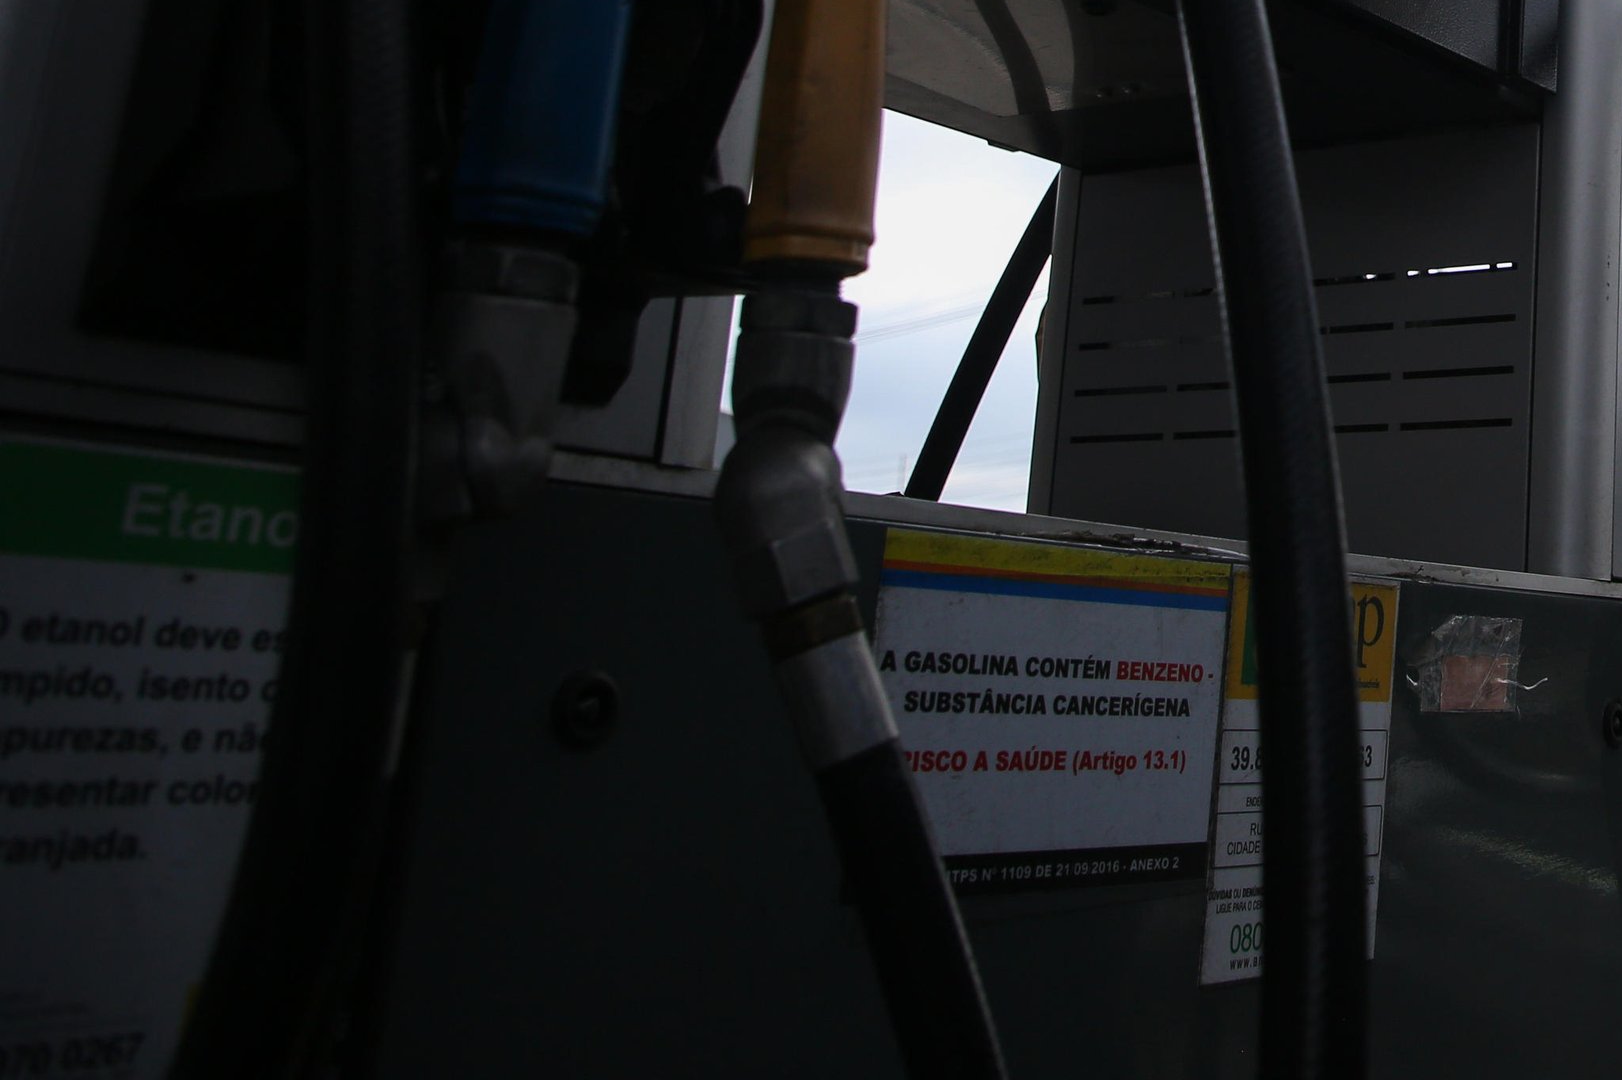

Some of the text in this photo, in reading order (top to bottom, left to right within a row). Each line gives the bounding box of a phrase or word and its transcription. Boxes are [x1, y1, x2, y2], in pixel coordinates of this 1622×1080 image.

[120, 482, 300, 549] Etano
[21, 612, 147, 648] etanol
[155, 618, 242, 652] deve
[880, 650, 897, 672] A
[904, 651, 1018, 677] GASOLINA
[1025, 655, 1110, 680] CONTÉM
[1116, 660, 1204, 683] BENZENO
[137, 667, 250, 704] isento
[903, 689, 1190, 718] SUBSTÂNCIA CANCERÍGENA
[972, 750, 989, 773] A
[995, 745, 1066, 773] SAÚDE
[1072, 750, 1137, 776] (Artigo
[1143, 750, 1186, 774] 13.1)
[1226, 840, 1260, 856] CIDADE
[1000, 865, 1032, 881] 1109
[1035, 863, 1052, 878] DE
[1129, 858, 1169, 872] ANEXO
[1171, 856, 1180, 869] 2
